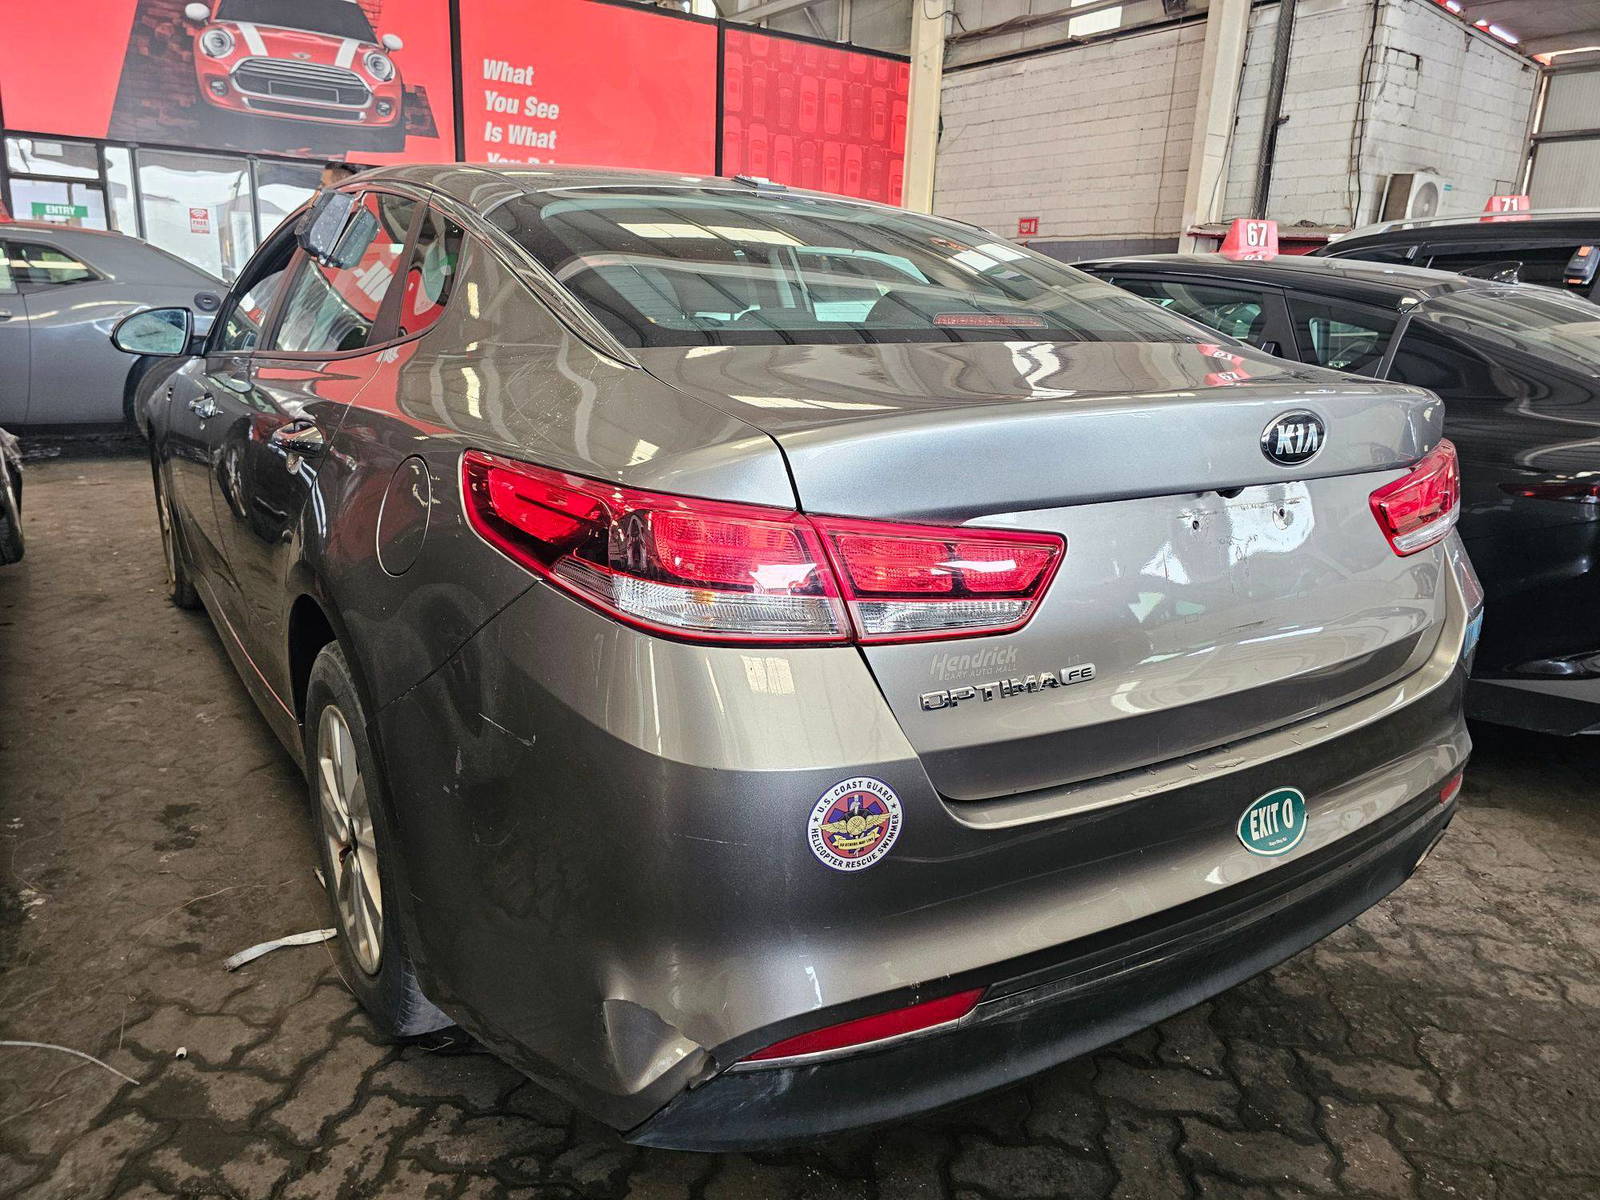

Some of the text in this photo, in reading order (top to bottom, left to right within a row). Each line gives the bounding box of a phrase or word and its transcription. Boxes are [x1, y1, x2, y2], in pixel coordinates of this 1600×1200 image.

[483, 58, 534, 86] What
[485, 90, 560, 120] You See
[484, 121, 557, 150] Is What
[45, 204, 75, 215] ENTRY
[1501, 197, 1518, 211] 71
[1247, 222, 1269, 247] 67
[1275, 423, 1318, 454] KIA
[930, 645, 1018, 681] Hendrick
[919, 667, 1092, 712] OPTIMA FE
[834, 780, 863, 797] COAST
[866, 780, 892, 802] GUARD
[1250, 802, 1279, 841] EXIT
[811, 813, 900, 869] HELICOPTER RESCUE SWIMMER
